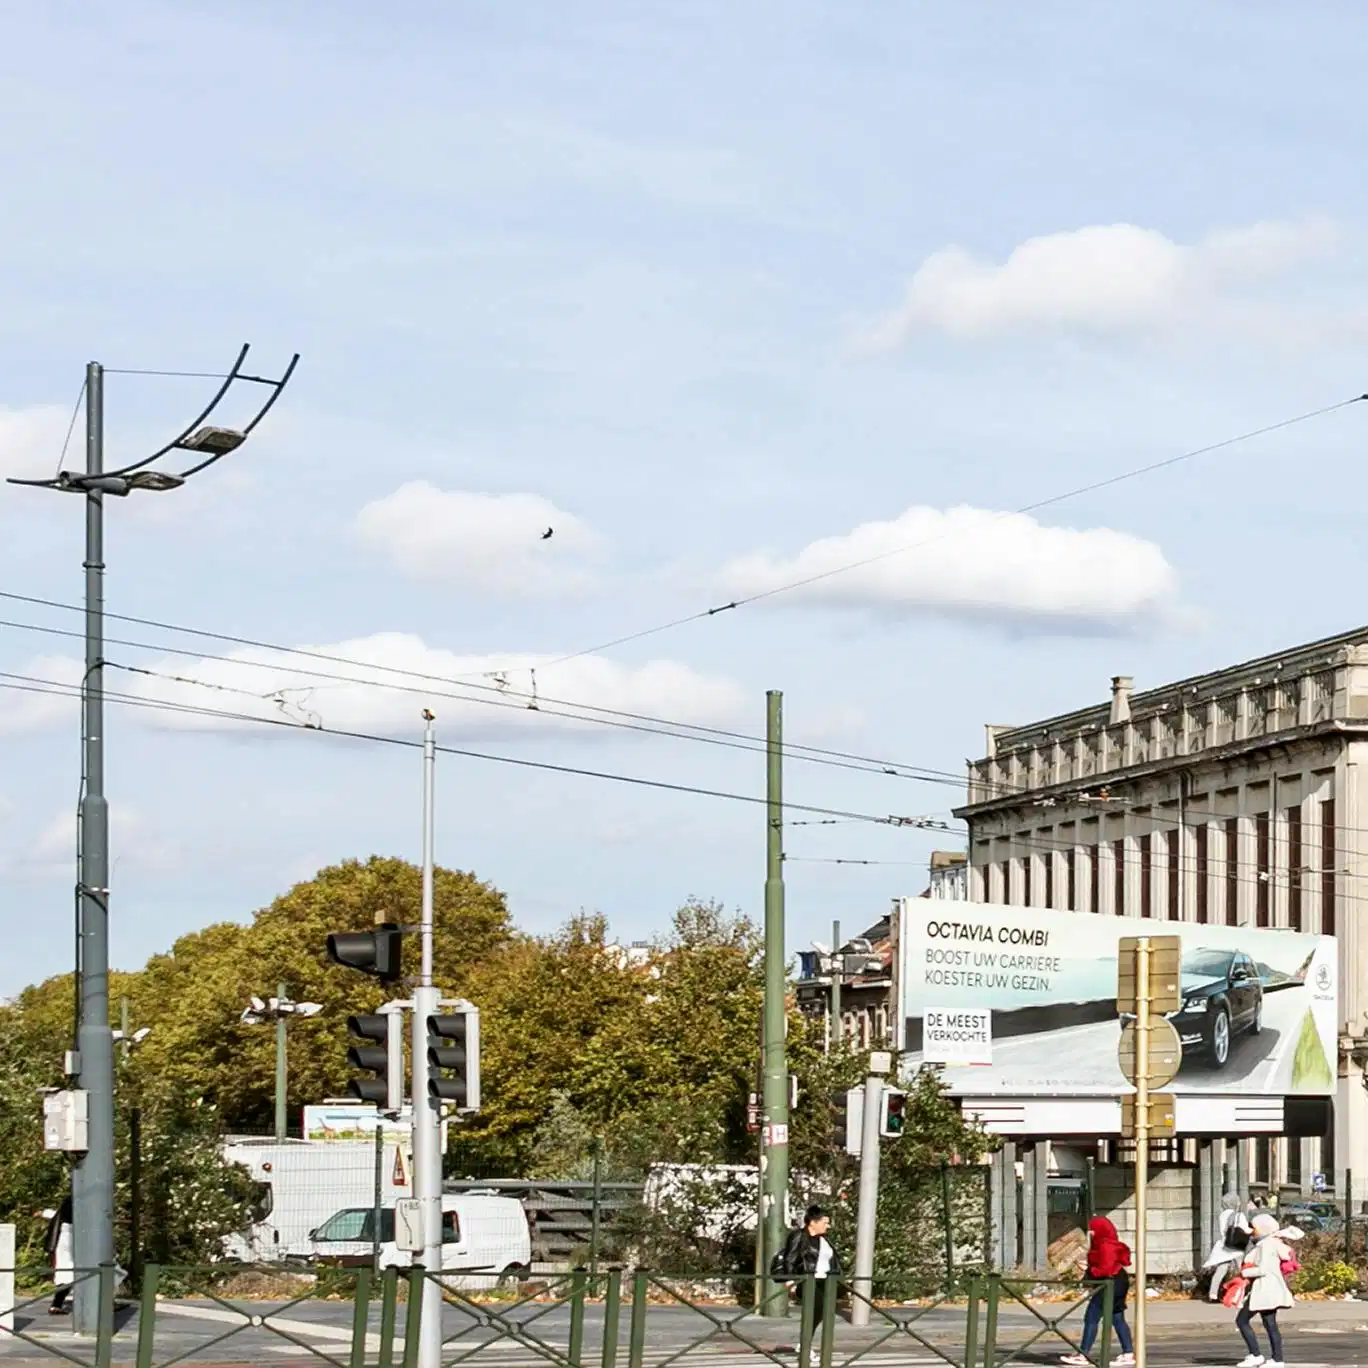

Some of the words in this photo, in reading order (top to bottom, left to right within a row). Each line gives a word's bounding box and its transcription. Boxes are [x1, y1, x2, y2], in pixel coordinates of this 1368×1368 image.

[927, 921, 994, 942] OCTAVIA
[998, 927, 1050, 947] COMBI
[925, 948, 970, 966] BOOST
[973, 952, 998, 967] UW
[925, 969, 983, 988] KOESTER
[985, 973, 1009, 988] UW
[927, 1013, 943, 1027] DE
[947, 1015, 987, 1029] MEEST
[926, 1030, 987, 1043] VERKOCHTE
